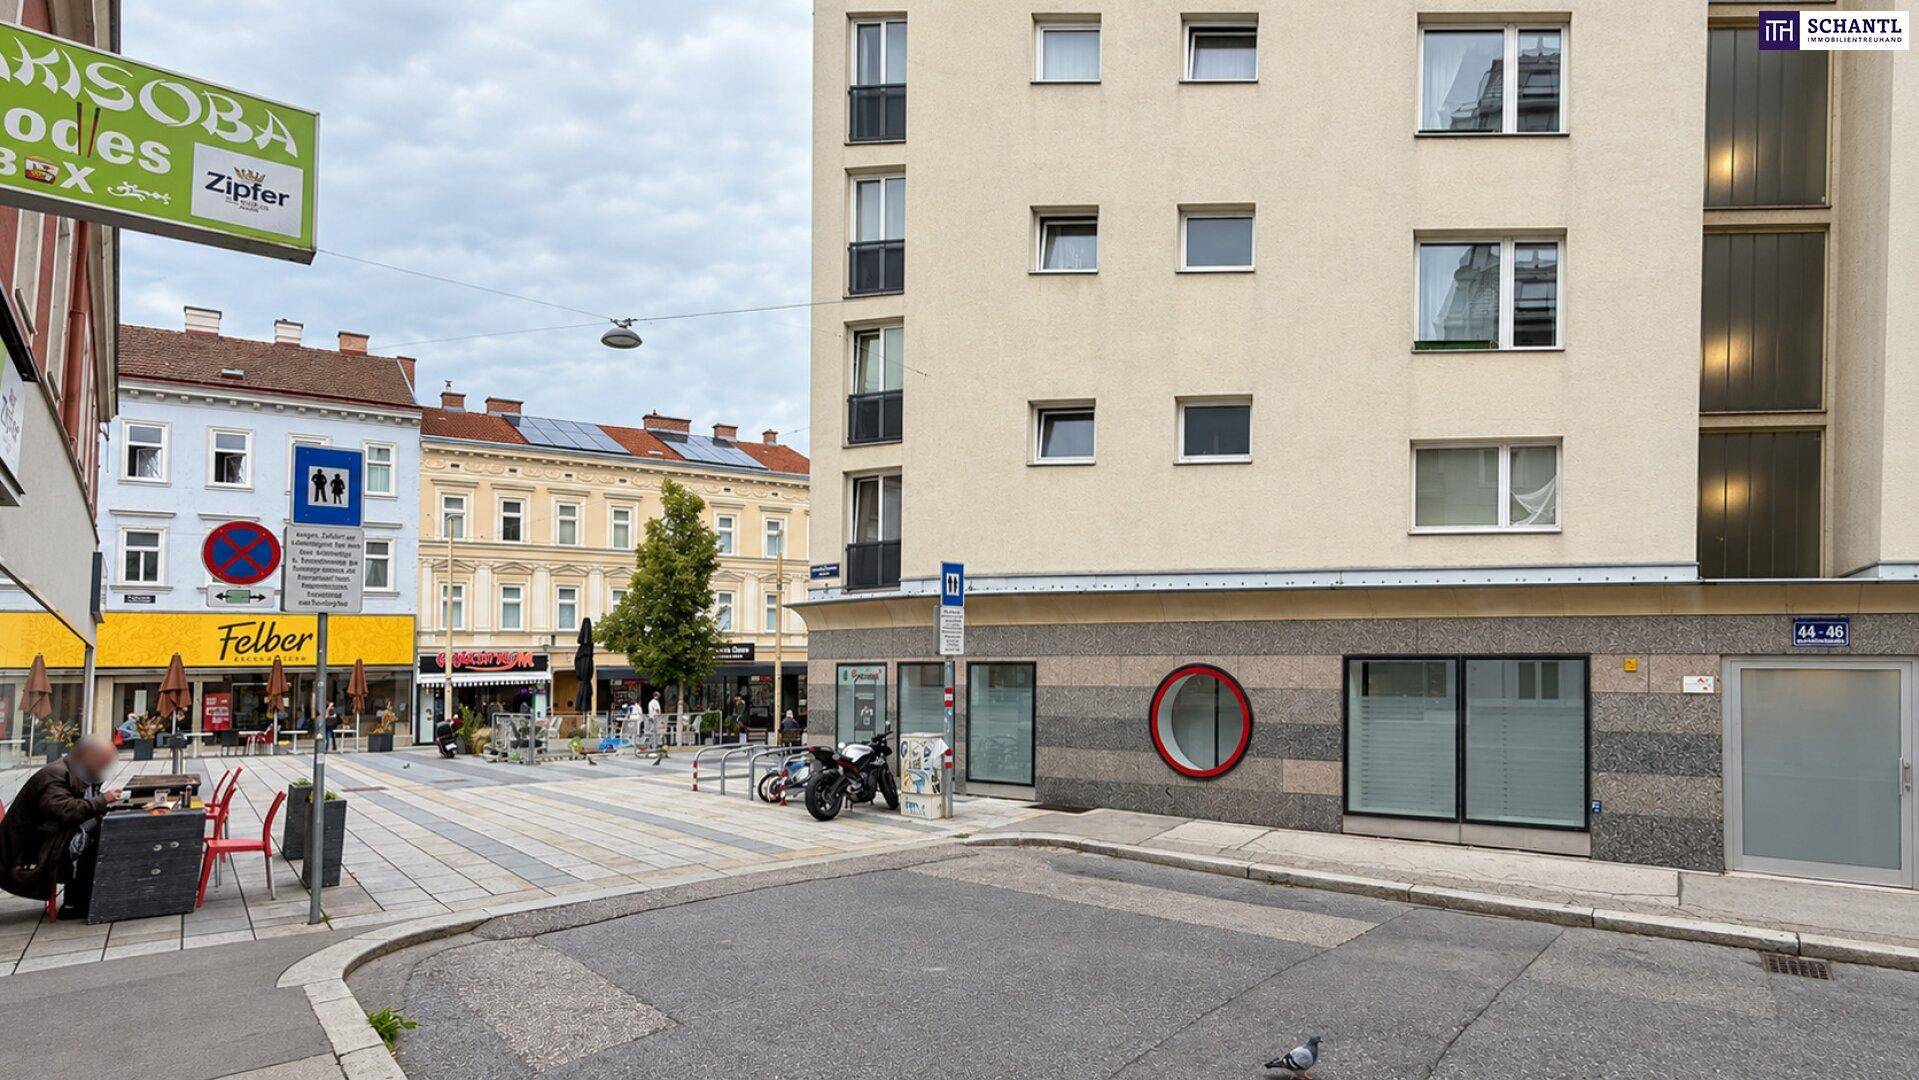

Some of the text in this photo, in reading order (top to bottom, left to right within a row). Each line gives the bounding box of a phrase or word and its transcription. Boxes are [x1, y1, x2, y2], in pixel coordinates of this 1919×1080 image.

[205, 170, 290, 207] Zipfer
[217, 621, 314, 661] Felber
[1798, 625, 1816, 638] 44
[1825, 625, 1844, 638] 46
